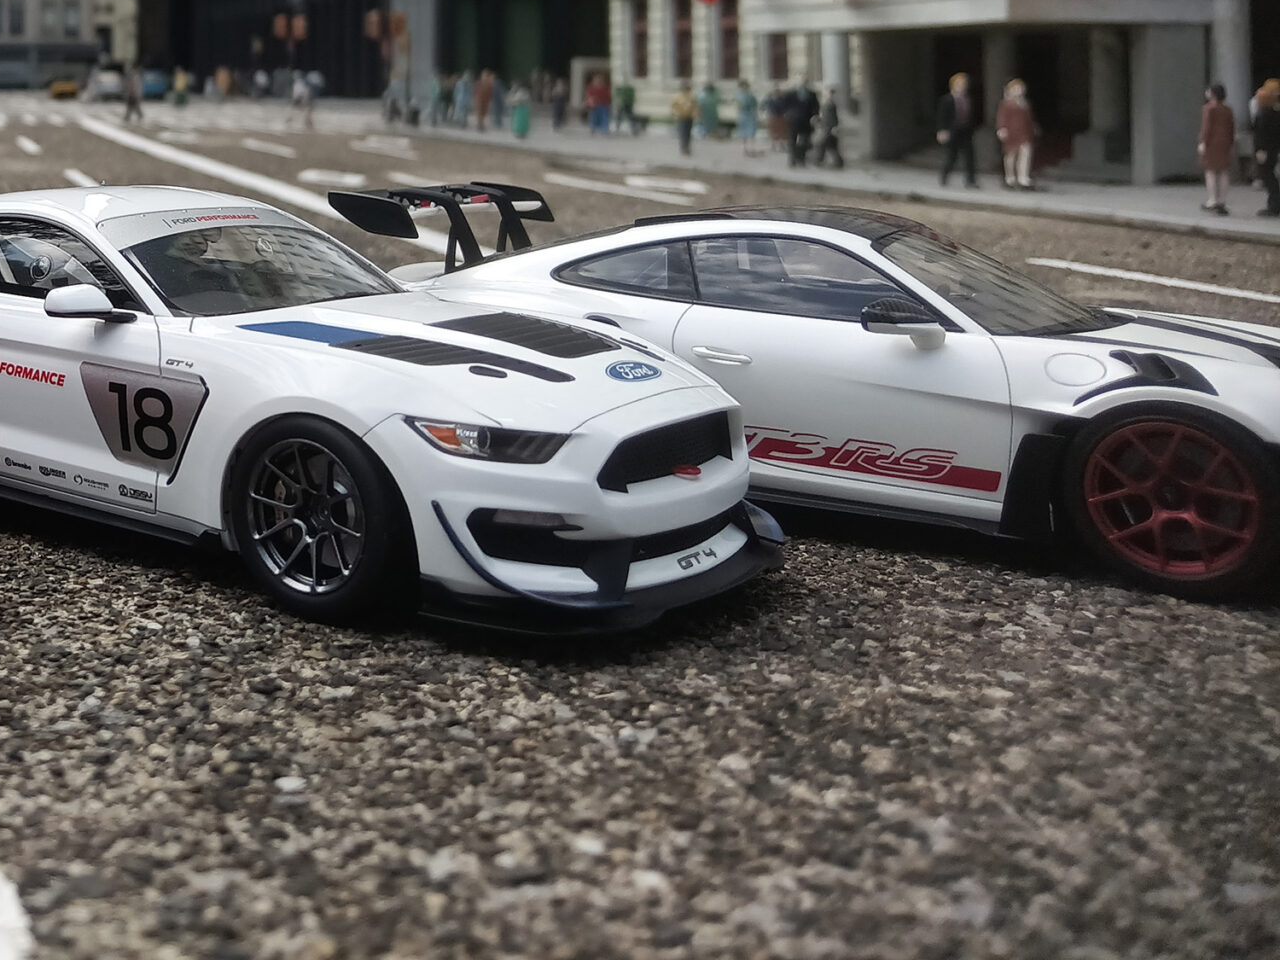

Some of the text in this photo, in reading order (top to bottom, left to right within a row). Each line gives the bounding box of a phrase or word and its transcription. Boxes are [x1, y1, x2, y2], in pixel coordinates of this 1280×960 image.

[171, 214, 260, 226] FORD PERFORMANCE
[616, 363, 654, 379] Ford
[108, 381, 177, 460] 18
[744, 425, 959, 479] T3RS
